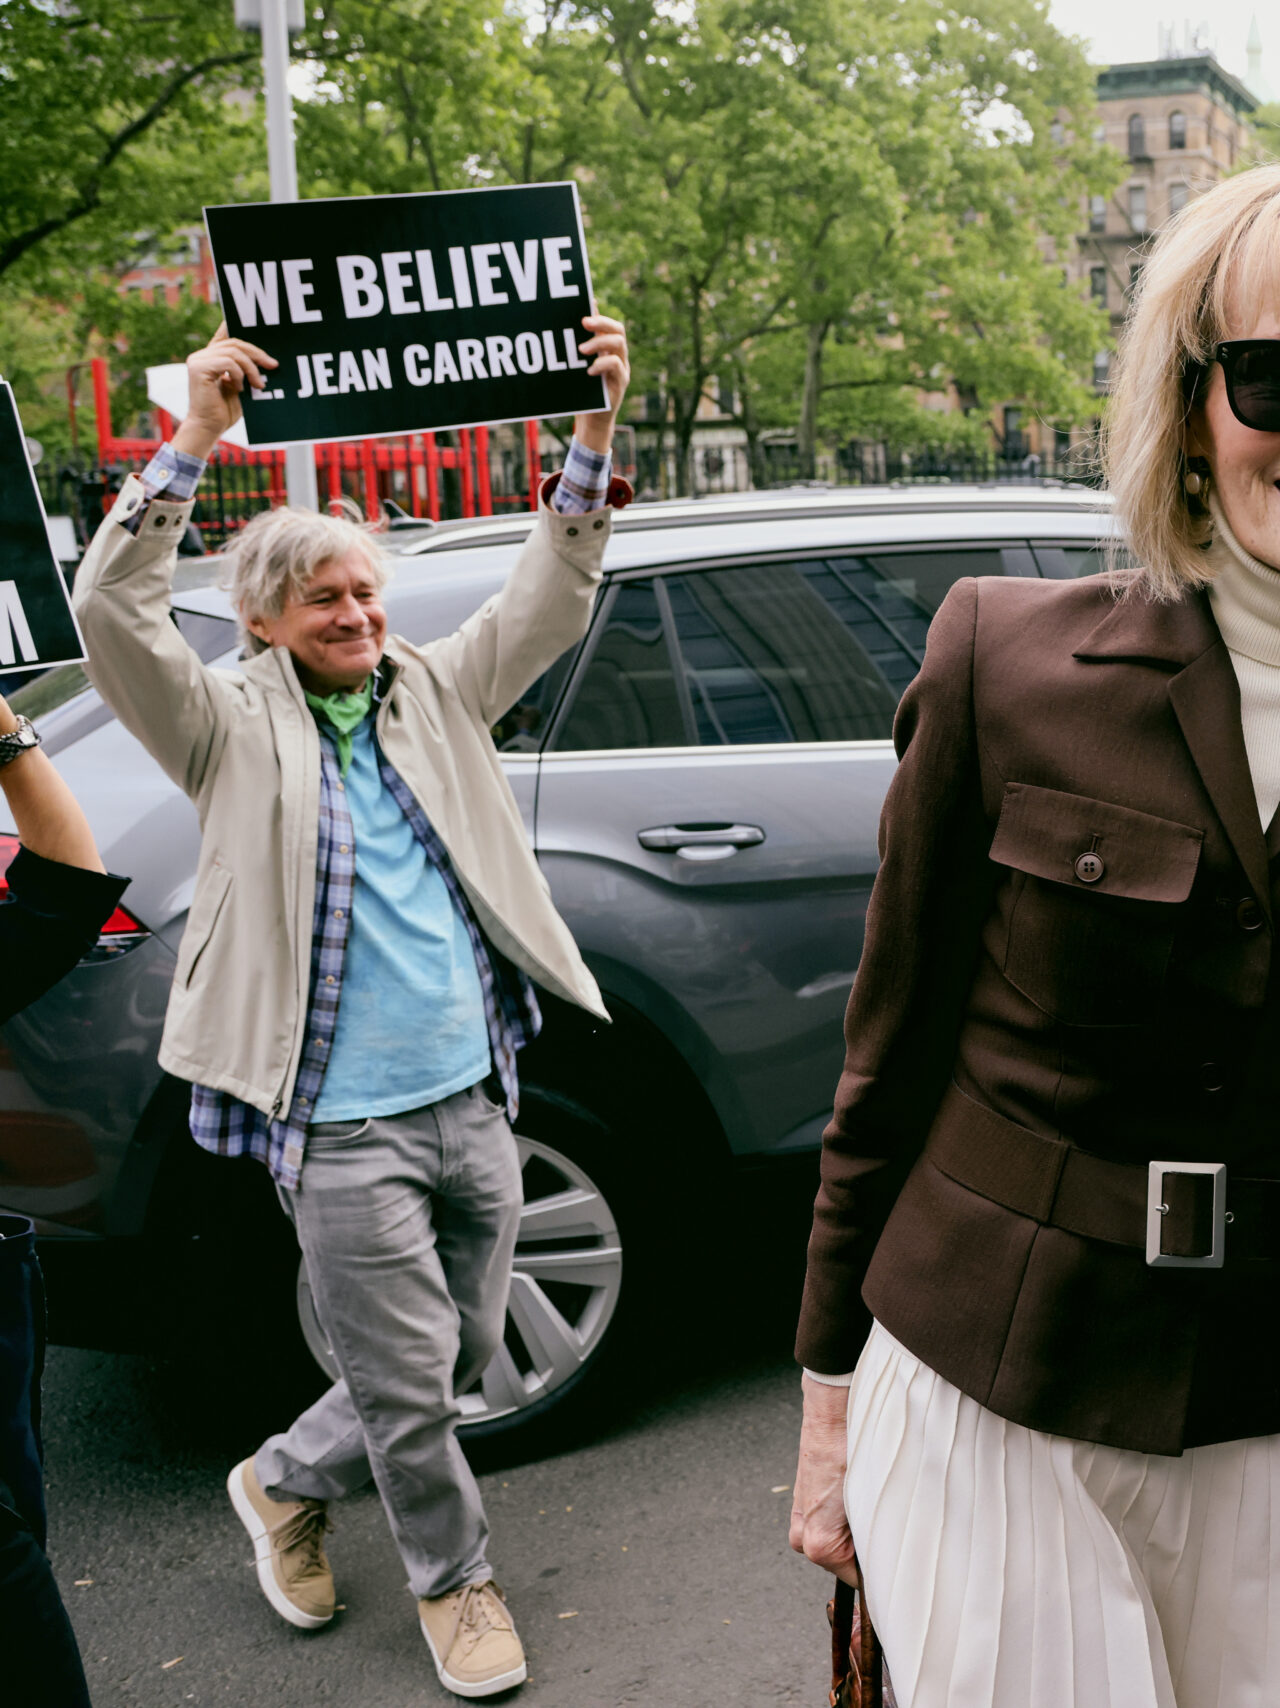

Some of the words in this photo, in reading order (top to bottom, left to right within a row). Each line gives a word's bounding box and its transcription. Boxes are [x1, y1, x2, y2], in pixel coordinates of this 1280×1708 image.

[223, 258, 323, 328] WE
[336, 236, 581, 319] BELIEVE
[296, 347, 393, 399] JEAN
[403, 328, 588, 387] CARROLL
